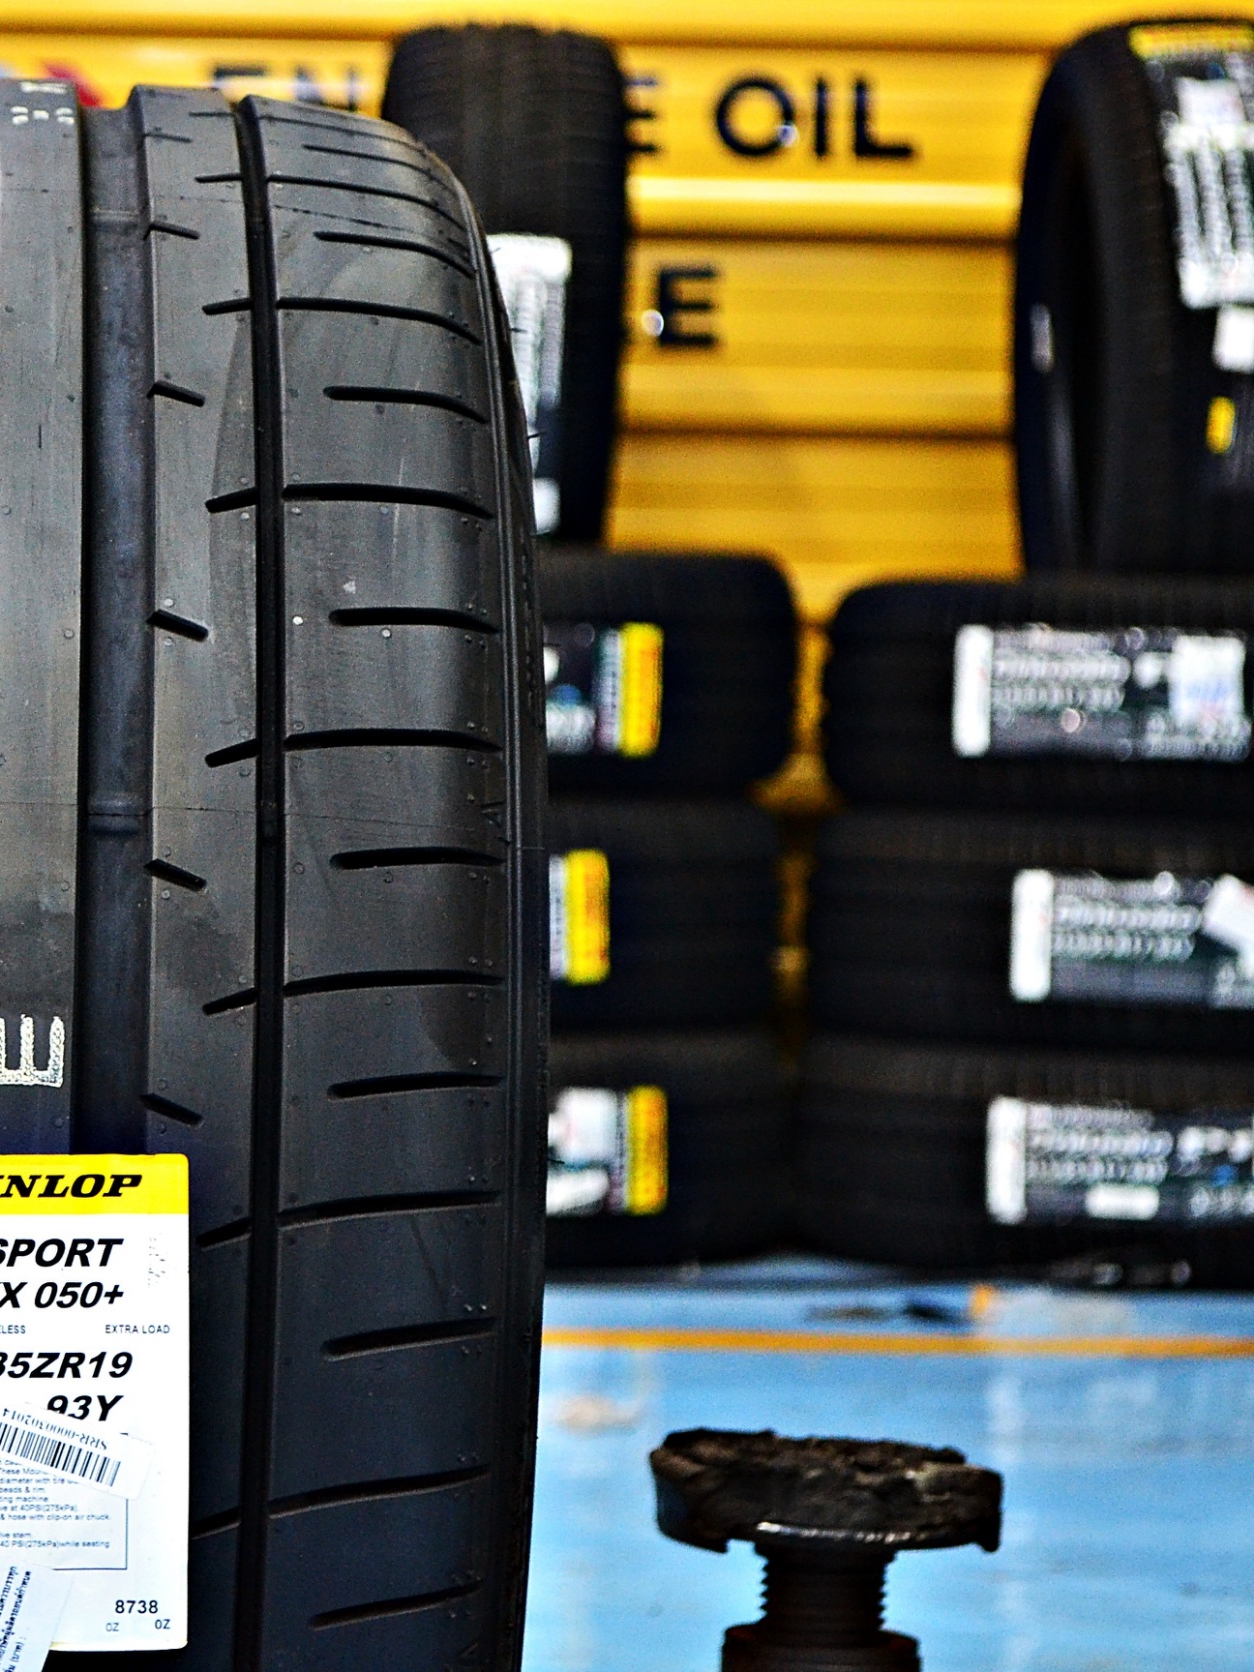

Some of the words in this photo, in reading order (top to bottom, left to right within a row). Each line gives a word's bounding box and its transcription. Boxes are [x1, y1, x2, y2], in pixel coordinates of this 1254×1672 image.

[715, 73, 914, 158] OIL
[34, 1282, 124, 1308] 050+
[105, 1325, 139, 1334] EXTRA
[142, 1325, 170, 1334] LOAD
[47, 1395, 124, 1421] 93Y
[115, 1600, 158, 1614] 8738
